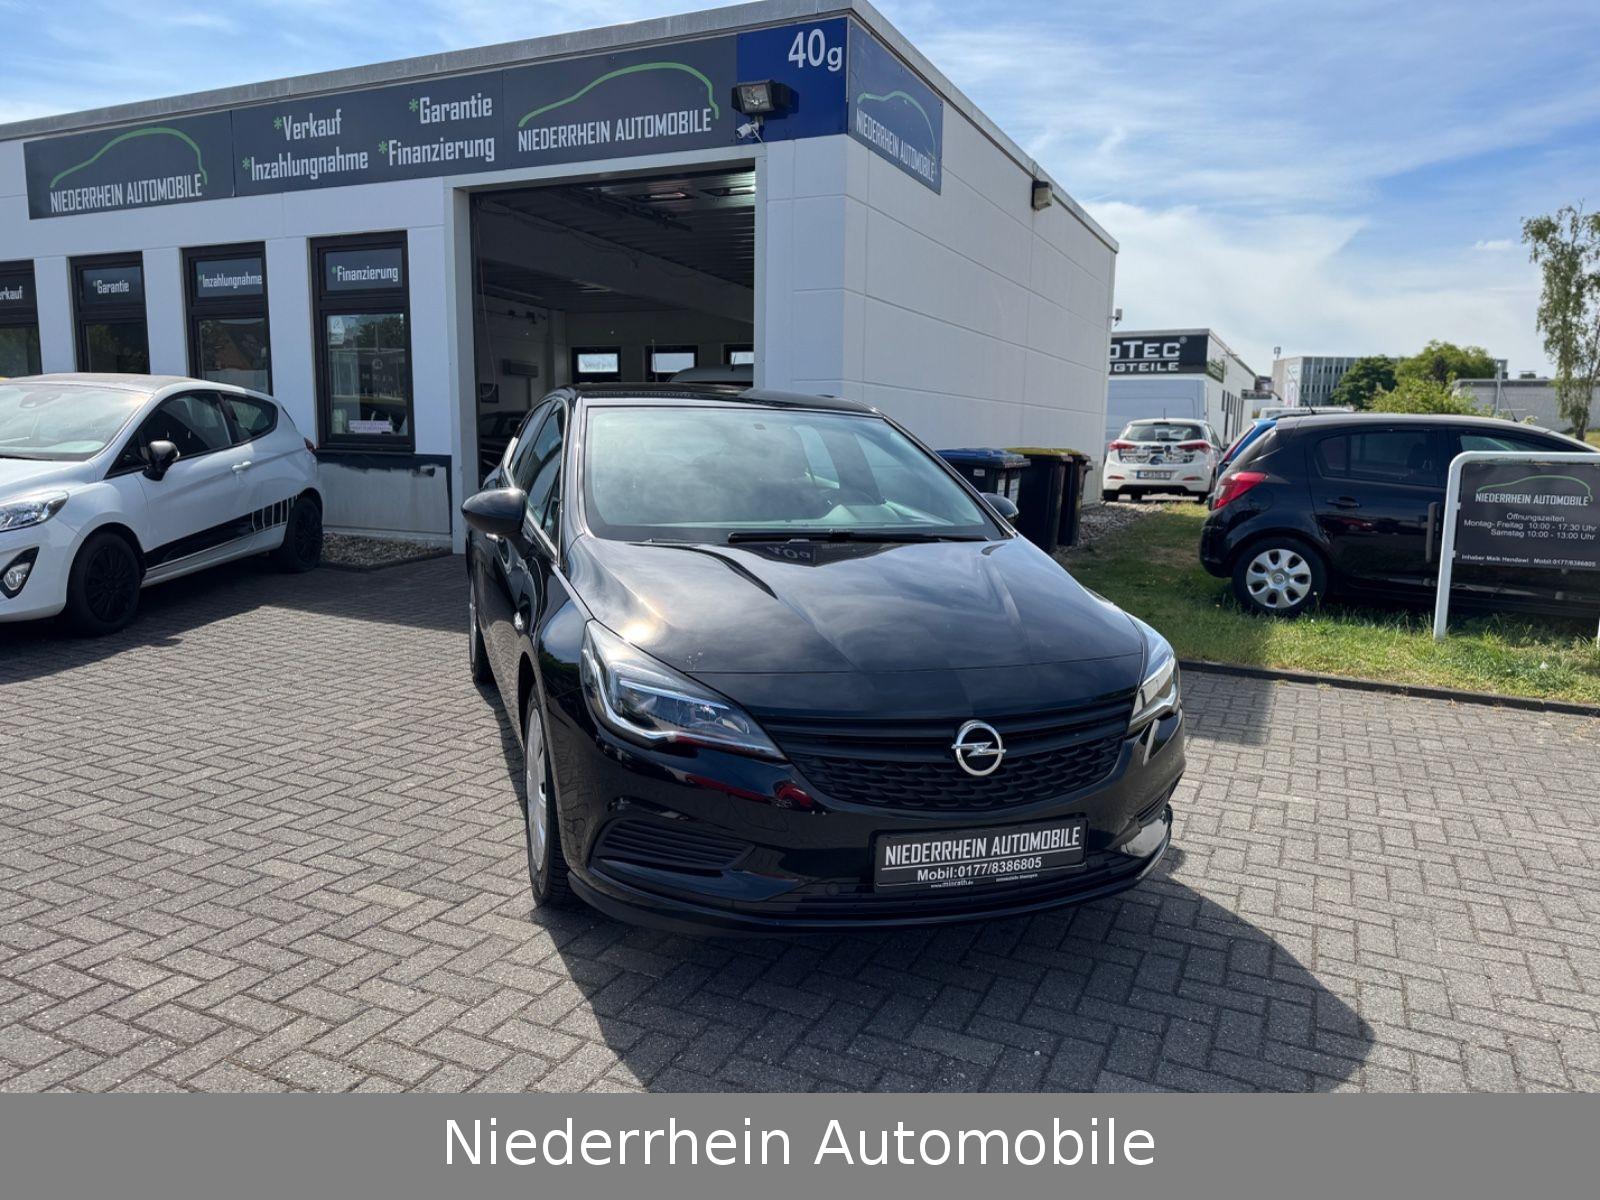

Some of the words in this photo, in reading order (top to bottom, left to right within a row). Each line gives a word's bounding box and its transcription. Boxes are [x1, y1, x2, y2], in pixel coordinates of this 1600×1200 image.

[788, 28, 843, 72] 40g
[518, 120, 611, 152] NIEDERRHEIN
[615, 108, 712, 140] AUTOMOBILE
[857, 107, 900, 159] NIEDERRHEIN
[900, 140, 935, 182] AUTOMOBILE
[50, 183, 124, 213] NIEDERRHEIN
[127, 173, 203, 204] AUTOMOBILE
[0, 285, 23, 300] rkauf
[1109, 362, 1180, 372] GTEILE
[1475, 492, 1531, 505] NIEDERRHEIN
[1533, 494, 1590, 507] AUTOMOBILE
[1490, 528, 1525, 538] Samstag
[1581, 532, 1596, 540] Uhr
[1497, 520, 1524, 530] Freitag
[1582, 524, 1597, 532] Uhr
[885, 837, 987, 867] NIEDERRHEIN
[991, 826, 1082, 856] AUTOMOBILE
[917, 856, 1042, 881] Mobil:0177/8386805
